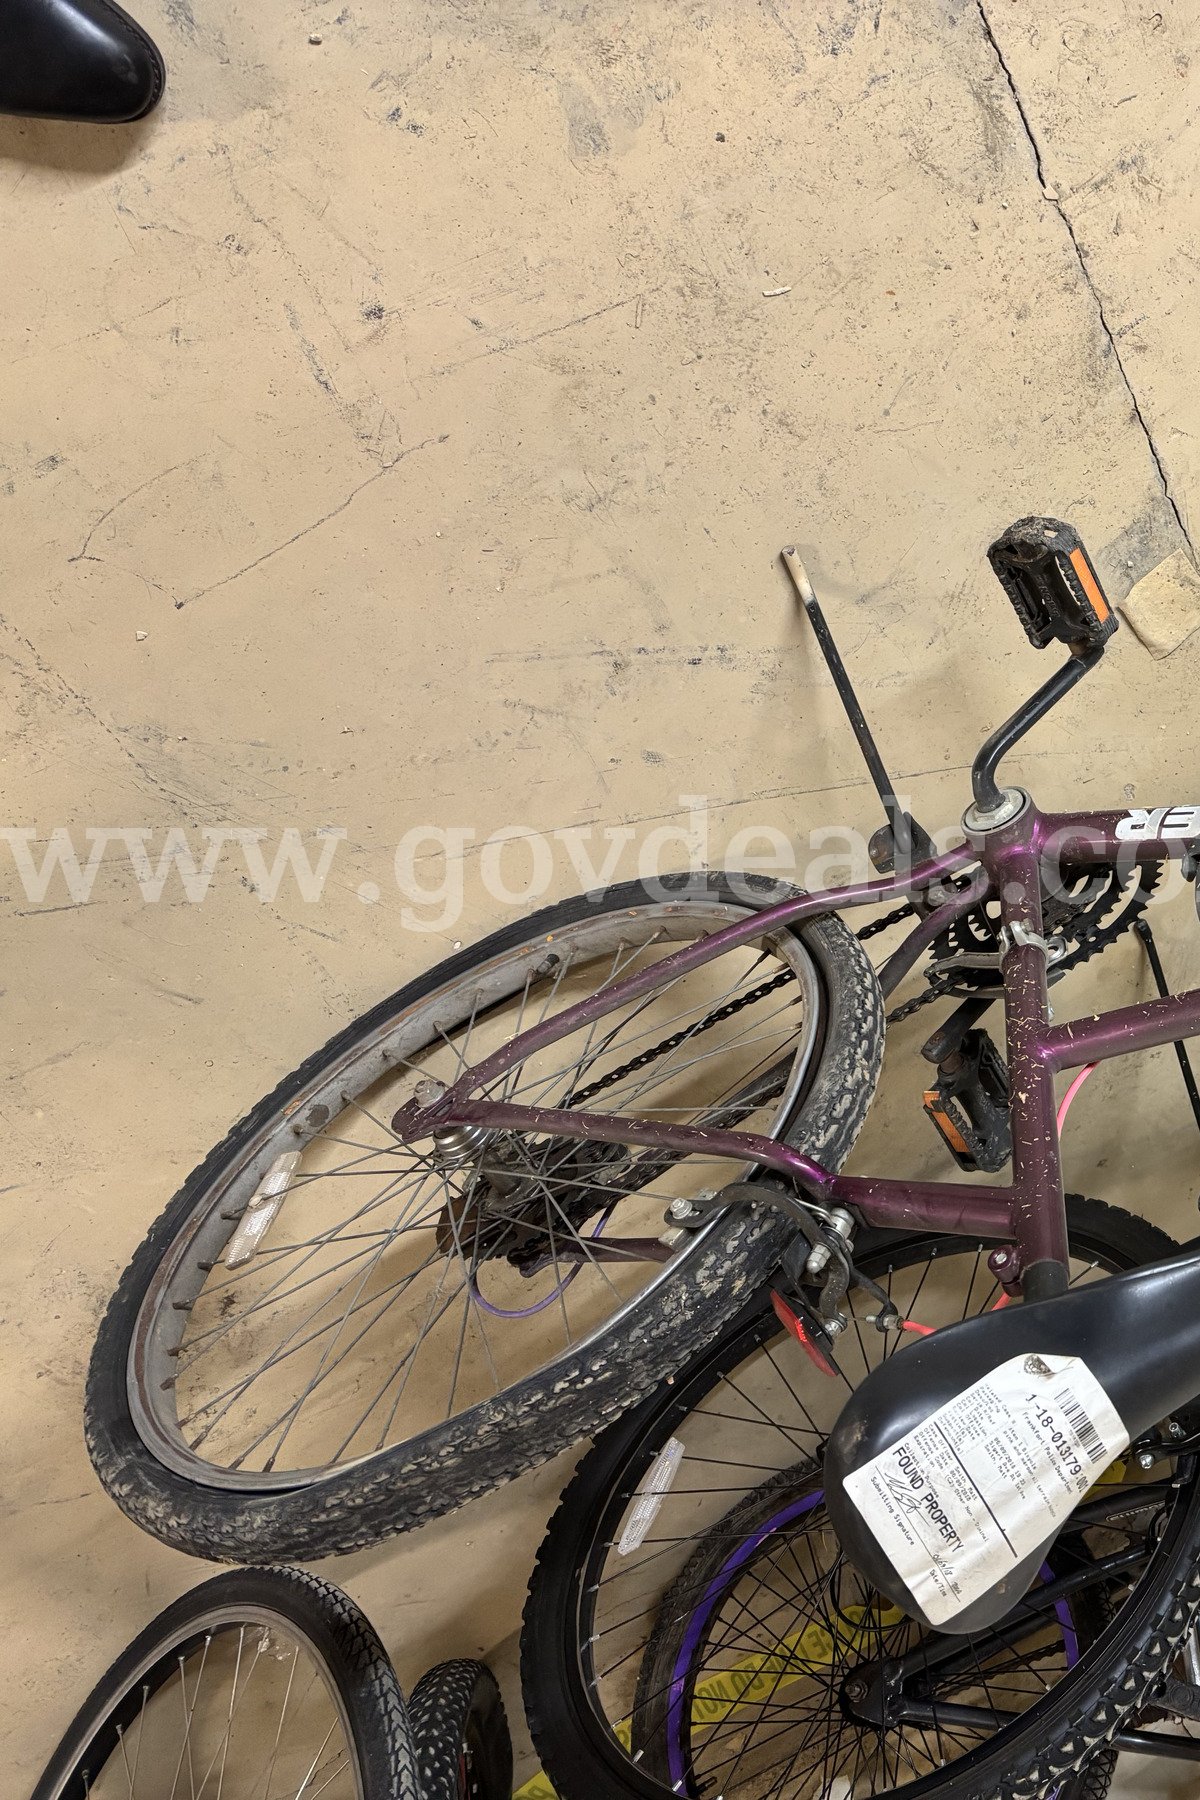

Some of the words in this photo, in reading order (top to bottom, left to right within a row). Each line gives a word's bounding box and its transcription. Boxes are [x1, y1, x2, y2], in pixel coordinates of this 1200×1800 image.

[1025, 1393, 1088, 1492] 1-18-013179:001
[870, 1475, 895, 1513] Submitting
[892, 1513, 916, 1547] Signature
[891, 1446, 925, 1491] FOUND
[919, 1491, 964, 1553] PROPERTY
